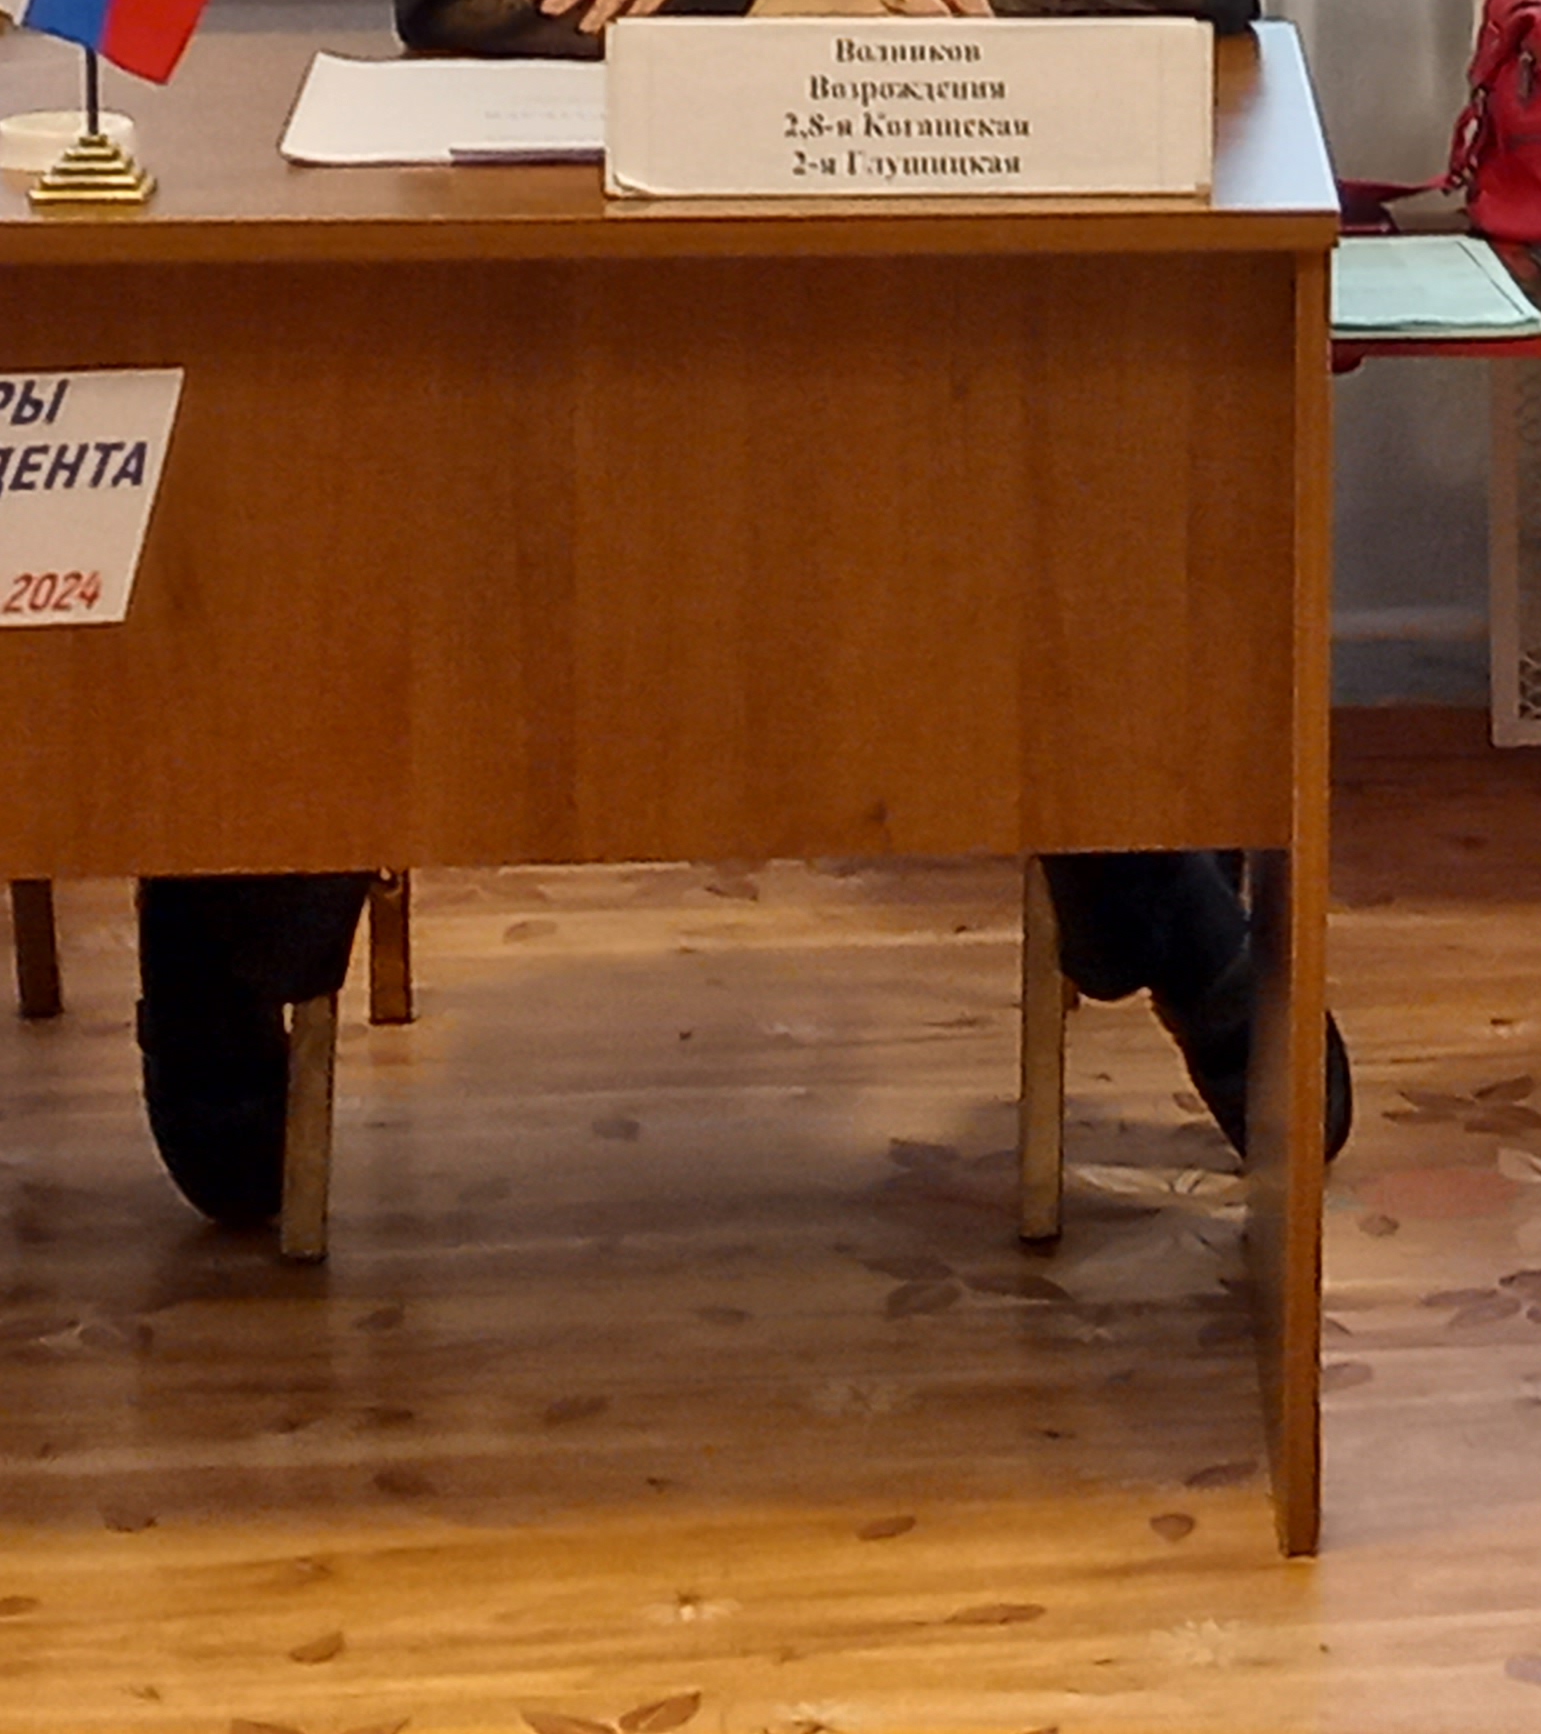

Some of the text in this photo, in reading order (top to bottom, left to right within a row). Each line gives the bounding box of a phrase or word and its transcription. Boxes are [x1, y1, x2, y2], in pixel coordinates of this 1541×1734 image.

[810, 74, 1006, 106] Возрождения
[783, 111, 853, 140] 2,8-я
[792, 148, 837, 176] 2-я
[3, 570, 102, 614] 2024
